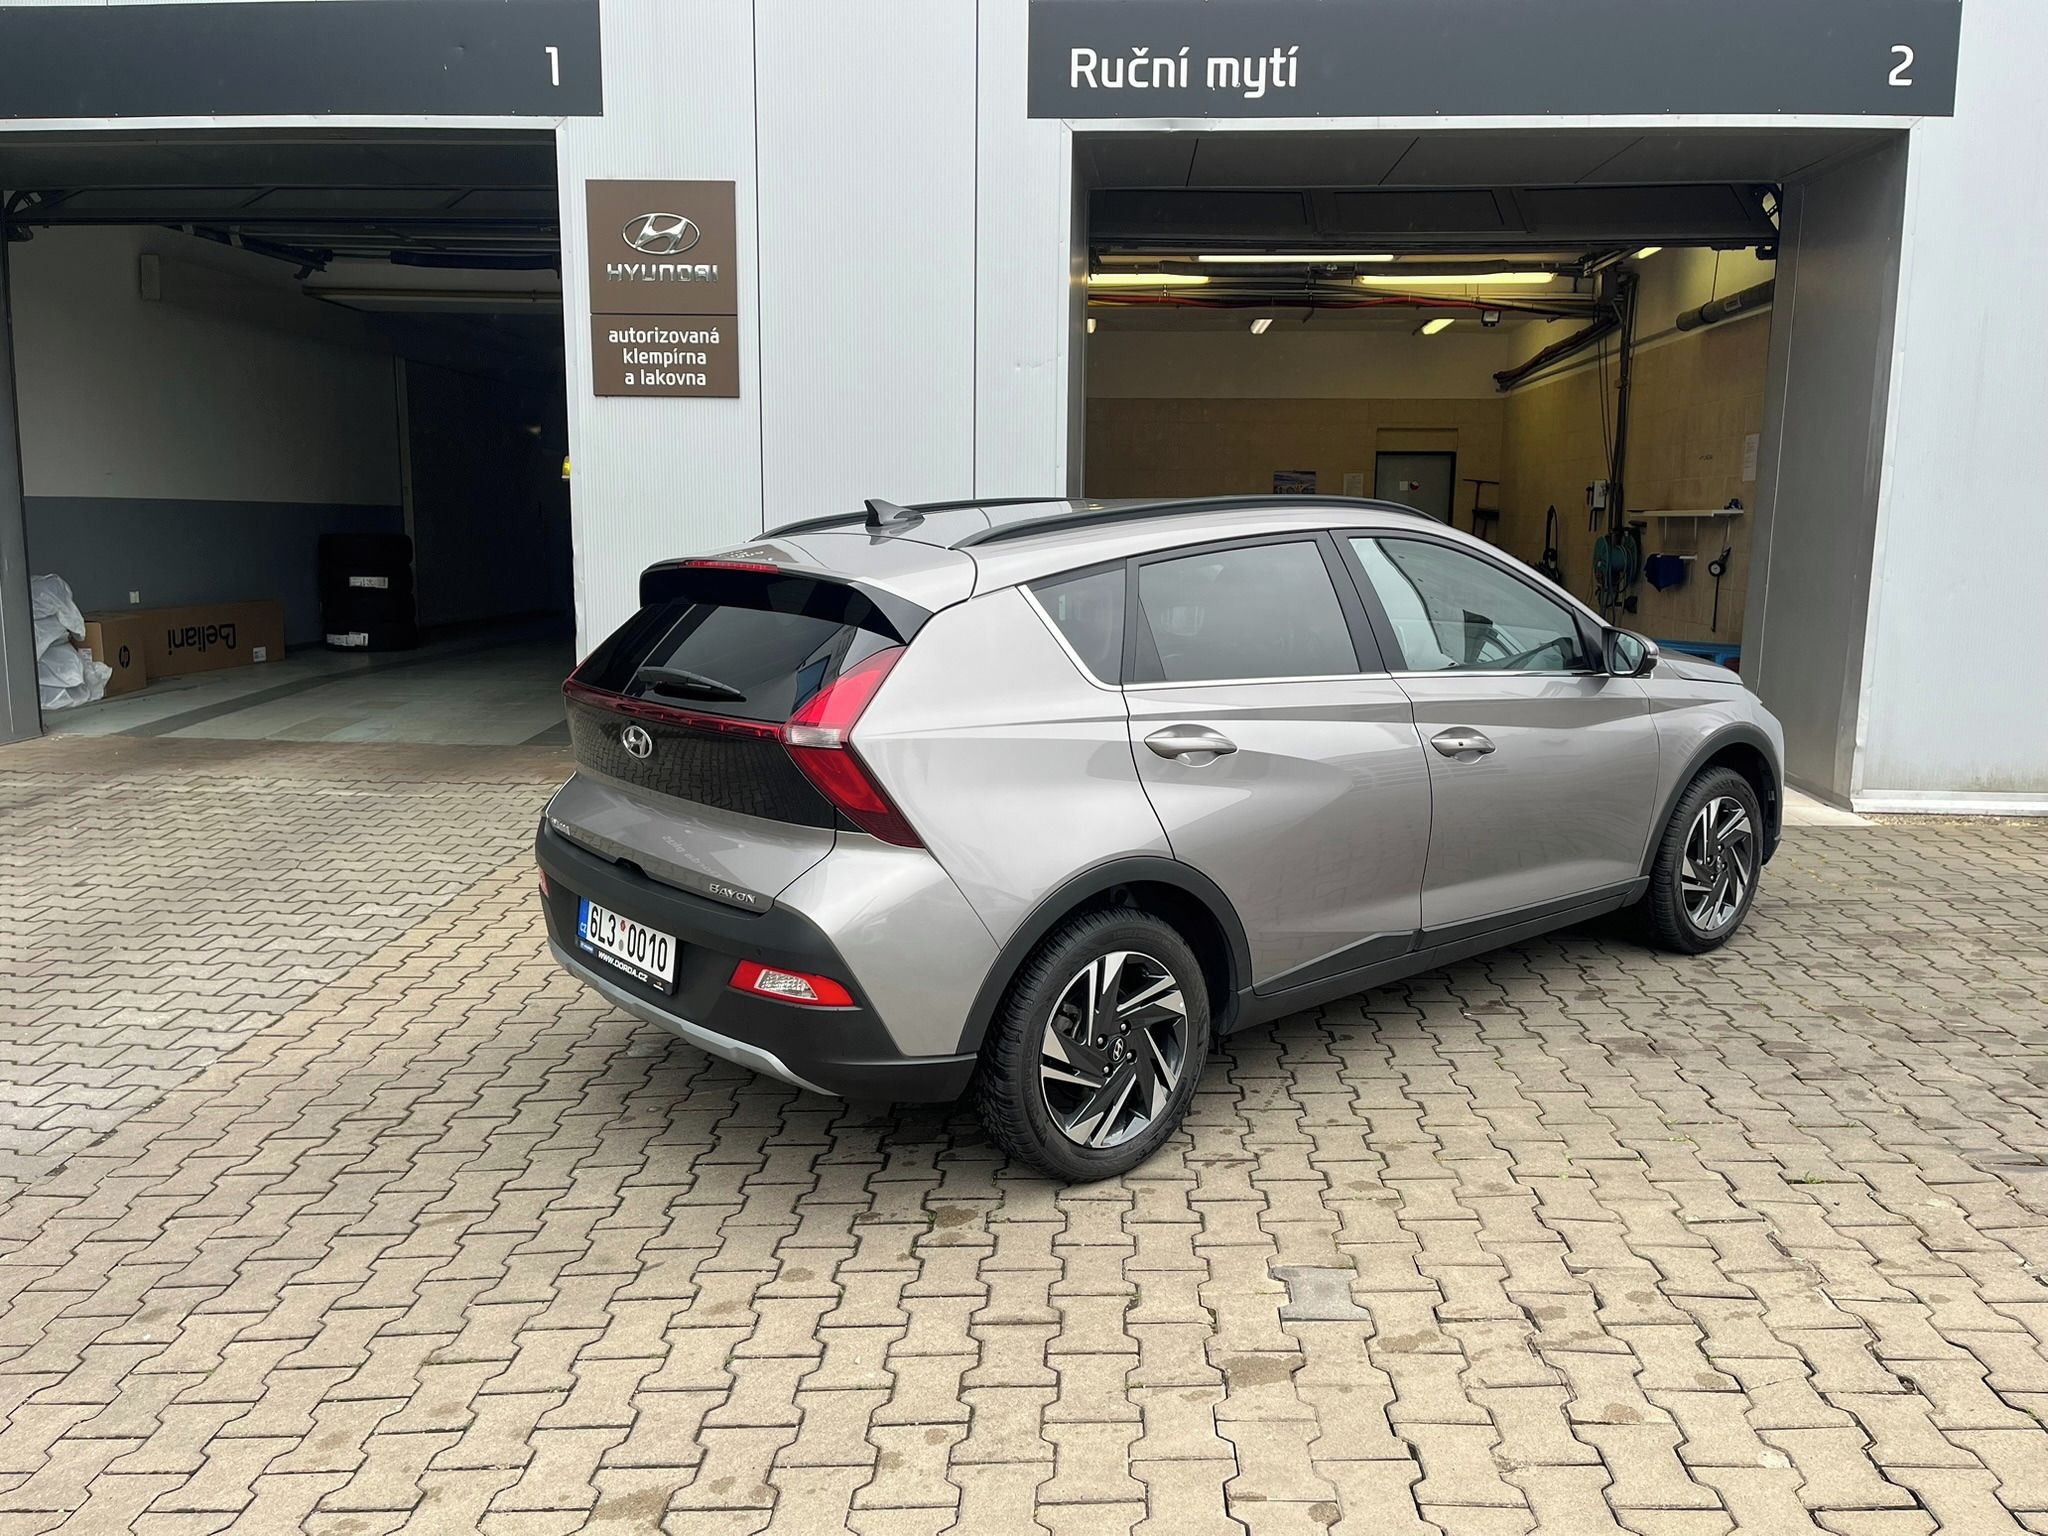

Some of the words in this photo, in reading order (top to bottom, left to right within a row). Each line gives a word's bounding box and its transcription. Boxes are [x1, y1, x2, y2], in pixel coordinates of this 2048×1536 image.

[545, 46, 560, 87] 1
[1070, 46, 1191, 89] Ruční
[1206, 45, 1300, 99] mytí
[1888, 44, 1914, 86] 2
[606, 262, 719, 282] HYUNDAI
[608, 326, 720, 345] autorizovaná
[622, 347, 708, 368] klempírna
[624, 371, 635, 386] a
[640, 369, 707, 387] lakovna
[167, 623, 237, 656] Beliani
[708, 882, 757, 905] BAYON
[580, 922, 588, 934] CZ
[590, 905, 617, 948] 6L3
[626, 923, 668, 973] 0010
